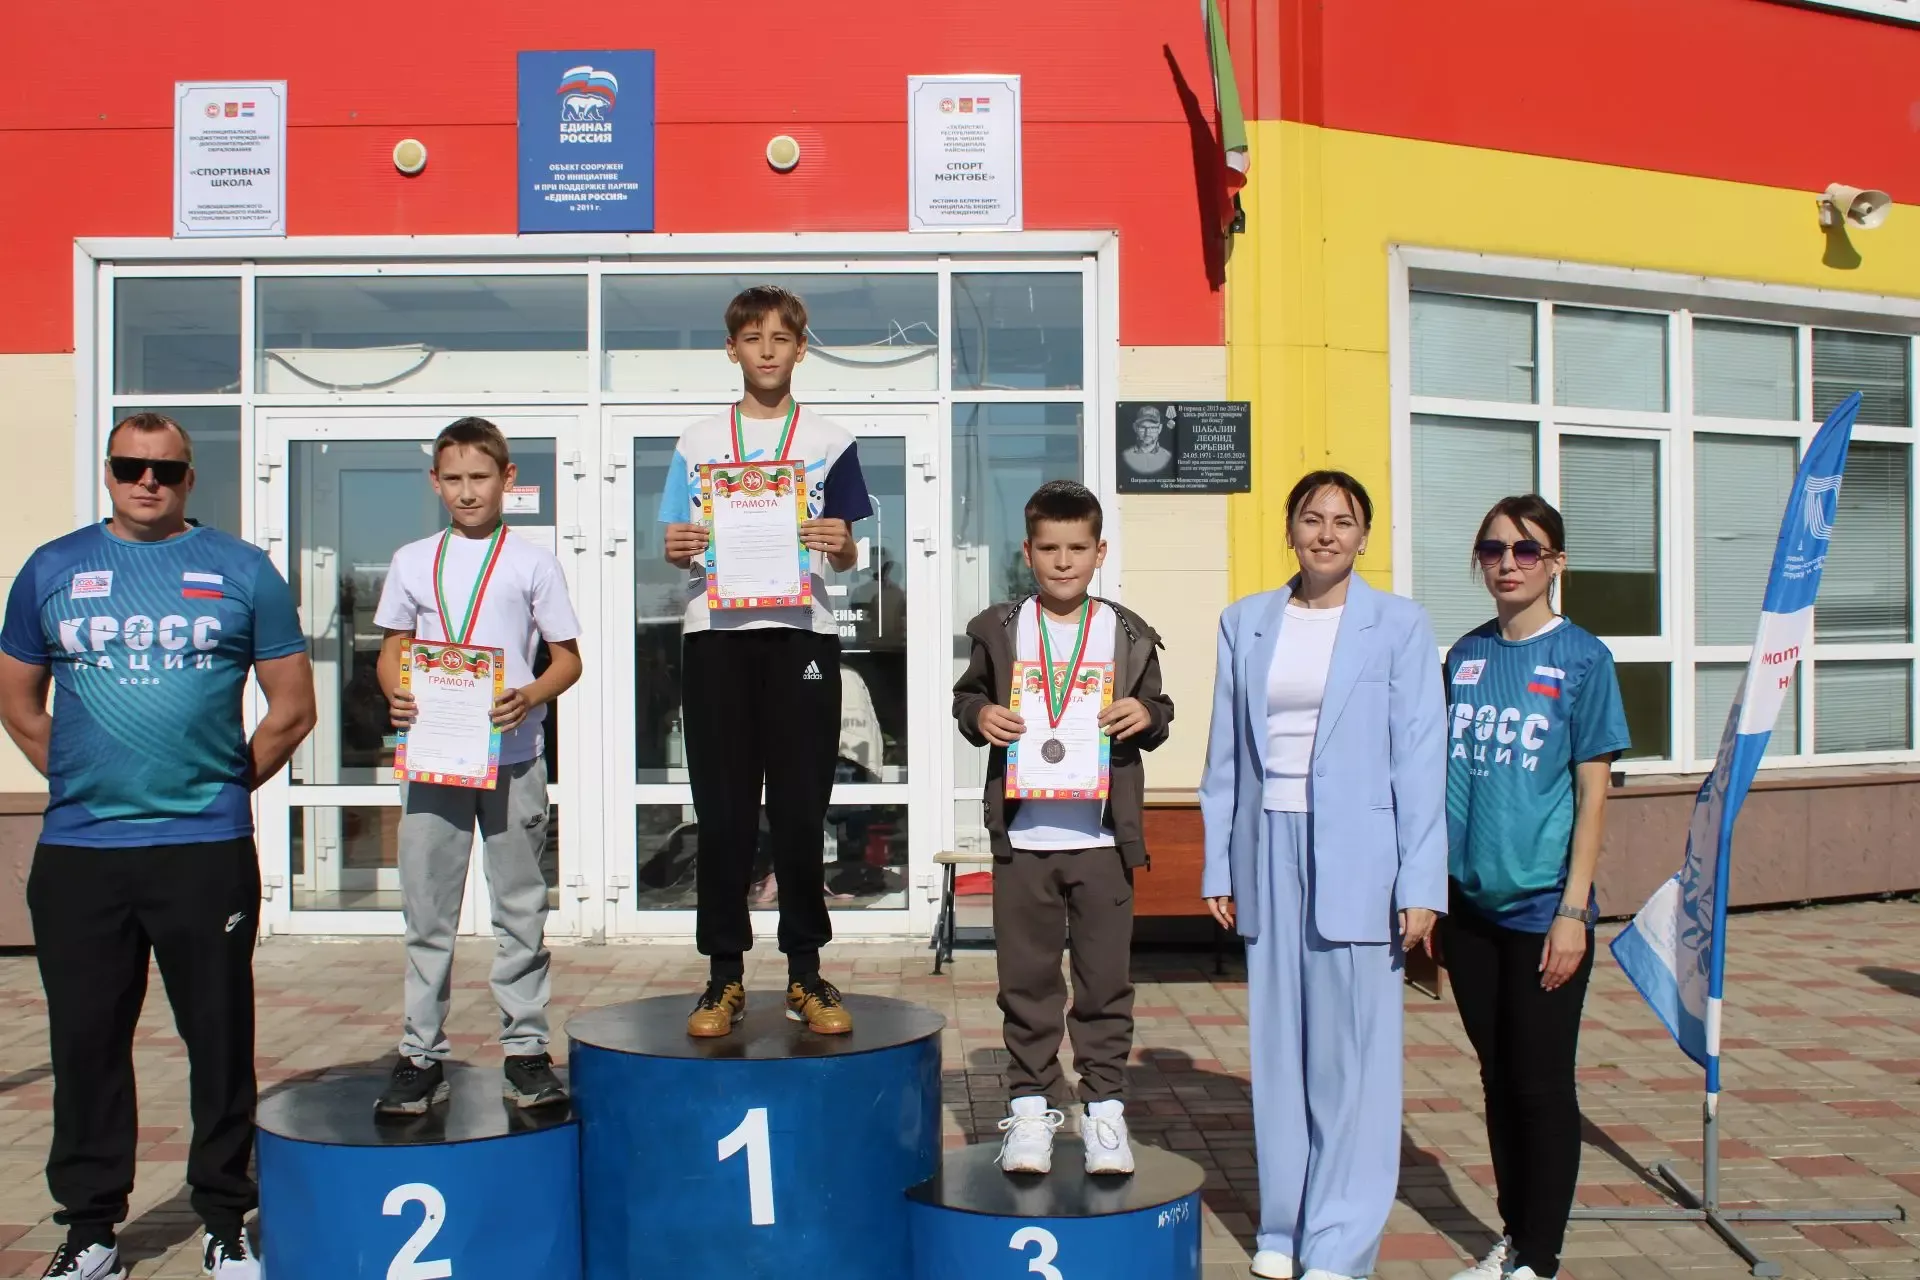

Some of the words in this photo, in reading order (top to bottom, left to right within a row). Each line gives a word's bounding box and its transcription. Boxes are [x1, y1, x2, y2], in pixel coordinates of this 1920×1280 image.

[560, 123, 612, 133] ЕДИНАЯ
[560, 133, 612, 143] РОССИЯ
[549, 163, 579, 171] ОБЪЕКТ
[946, 162, 984, 170] СПОРТ
[190, 168, 270, 176] «СПОРТИВНАЯ
[567, 173, 618, 181] ИНИЦИАТИВЕ
[211, 179, 253, 187] ШКОЛА
[558, 183, 606, 192] ПОДДЕРЖКЕ
[607, 182, 638, 190] ПАРТИИ
[545, 193, 587, 202] «ЕДИНАЯ
[588, 193, 628, 201] РОССИЯ»
[1192, 425, 1236, 433] ШАБАЛИН
[1196, 434, 1232, 442] ЛЕОНИД
[1194, 443, 1235, 451] ЮРЬЕВИЧ
[730, 498, 778, 509] ГРАМОТА
[833, 609, 863, 621] ЕНЬЕ
[59, 614, 222, 655] КРОСС
[803, 672, 822, 680] adidas
[428, 675, 475, 688] ГРАМОТА
[1451, 743, 1539, 771] АЦИИ
[718, 1107, 775, 1225] 1
[382, 1182, 452, 1280] 2
[1009, 1226, 1064, 1280] 3
